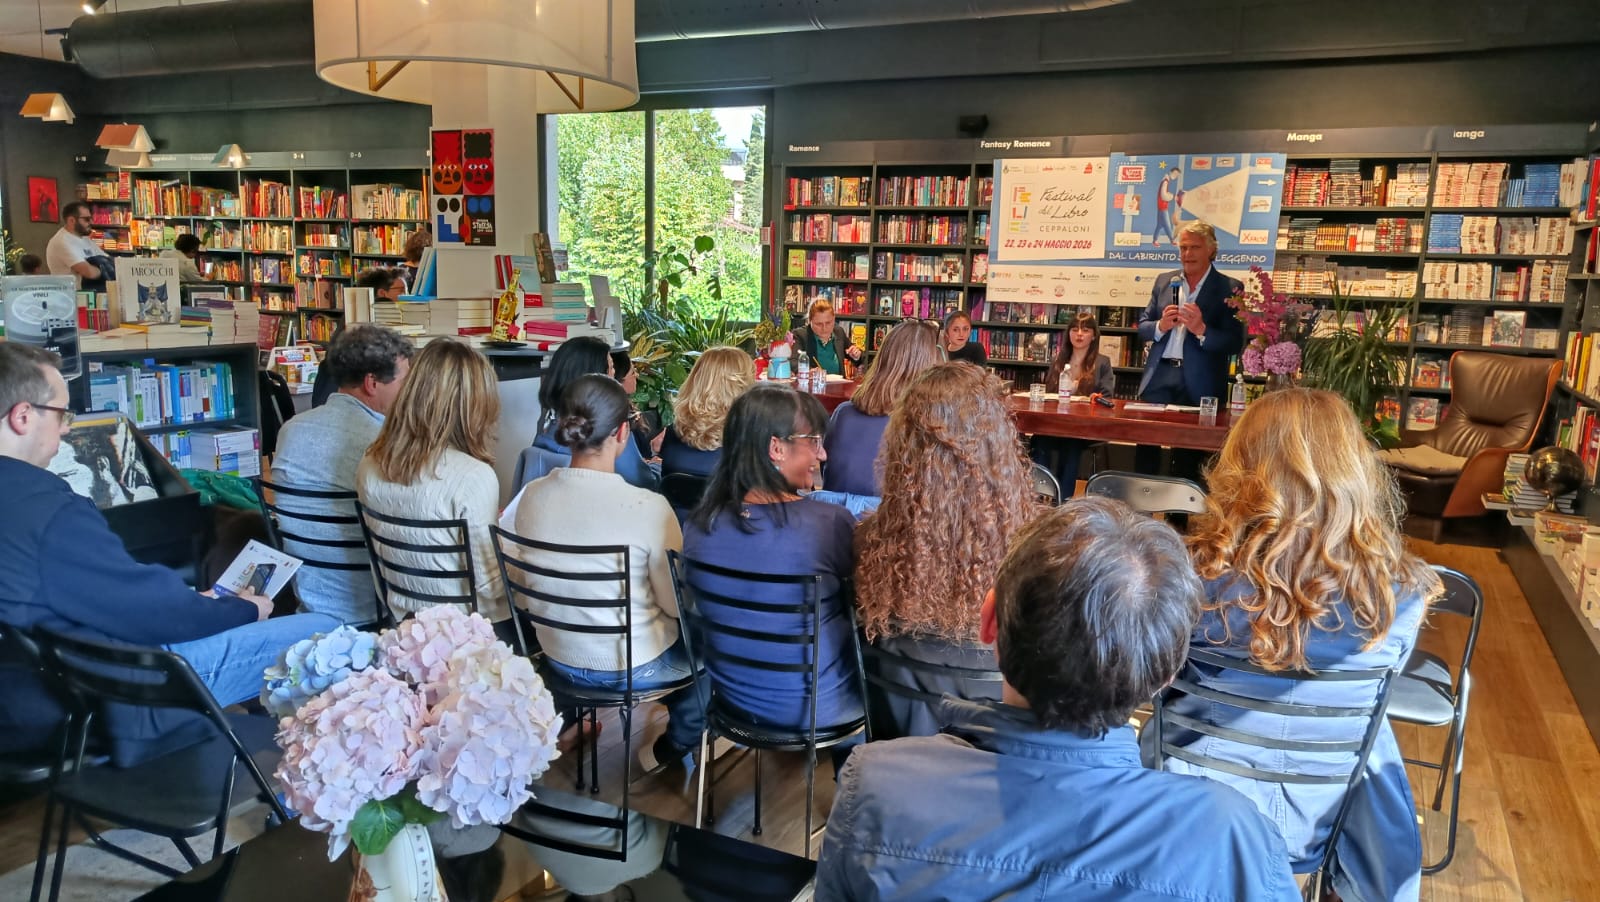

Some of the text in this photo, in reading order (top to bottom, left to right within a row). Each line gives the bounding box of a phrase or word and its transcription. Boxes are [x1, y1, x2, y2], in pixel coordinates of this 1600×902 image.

[1286, 132, 1323, 143] Manga
[980, 140, 1051, 150] Fantasy Romance
[1040, 186, 1096, 202] Festival
[1051, 205, 1089, 219] Libro
[1039, 225, 1090, 233] CEPPALONI
[1016, 239, 1026, 248] 23
[1033, 239, 1043, 249] 24
[1043, 239, 1072, 249] MAGGIO
[1072, 240, 1092, 249] 2026
[1108, 252, 1127, 260] DAL
[1128, 252, 1177, 261] LABIRINTO
[1215, 254, 1267, 264] LEGGENDO
[131, 266, 174, 277] TAROCCHI
